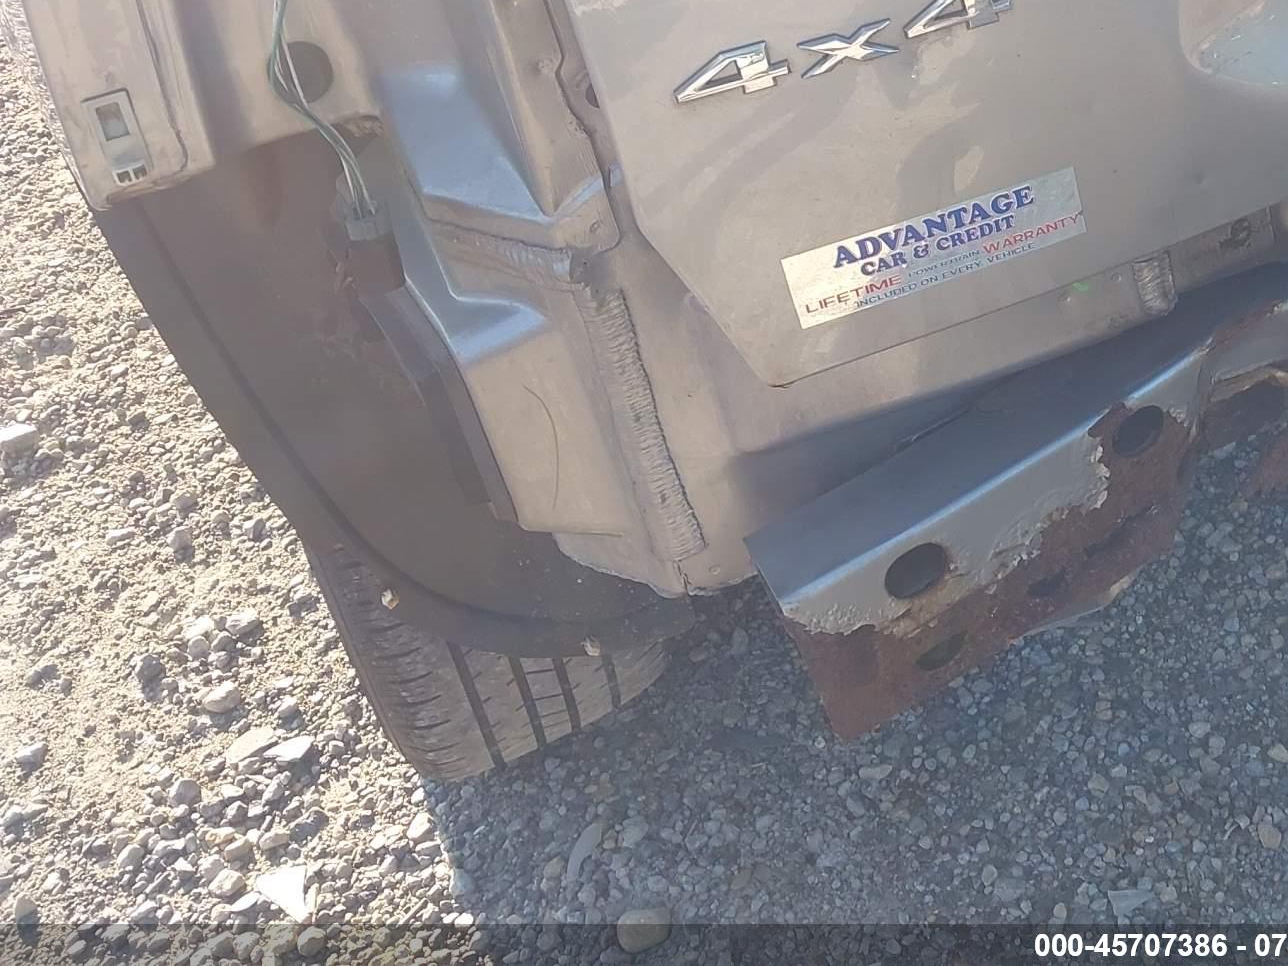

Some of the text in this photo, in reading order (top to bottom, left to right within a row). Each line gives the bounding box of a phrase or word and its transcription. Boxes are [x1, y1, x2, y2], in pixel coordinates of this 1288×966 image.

[805, 213, 1081, 314] LIFETIME POWERTRAIN WARRANTY
[833, 185, 1035, 269] ADVANTAGE
[860, 214, 1015, 276] CAR & CREDIT
[855, 242, 1036, 308] INCLUDED ON EVERY VEHICLE
